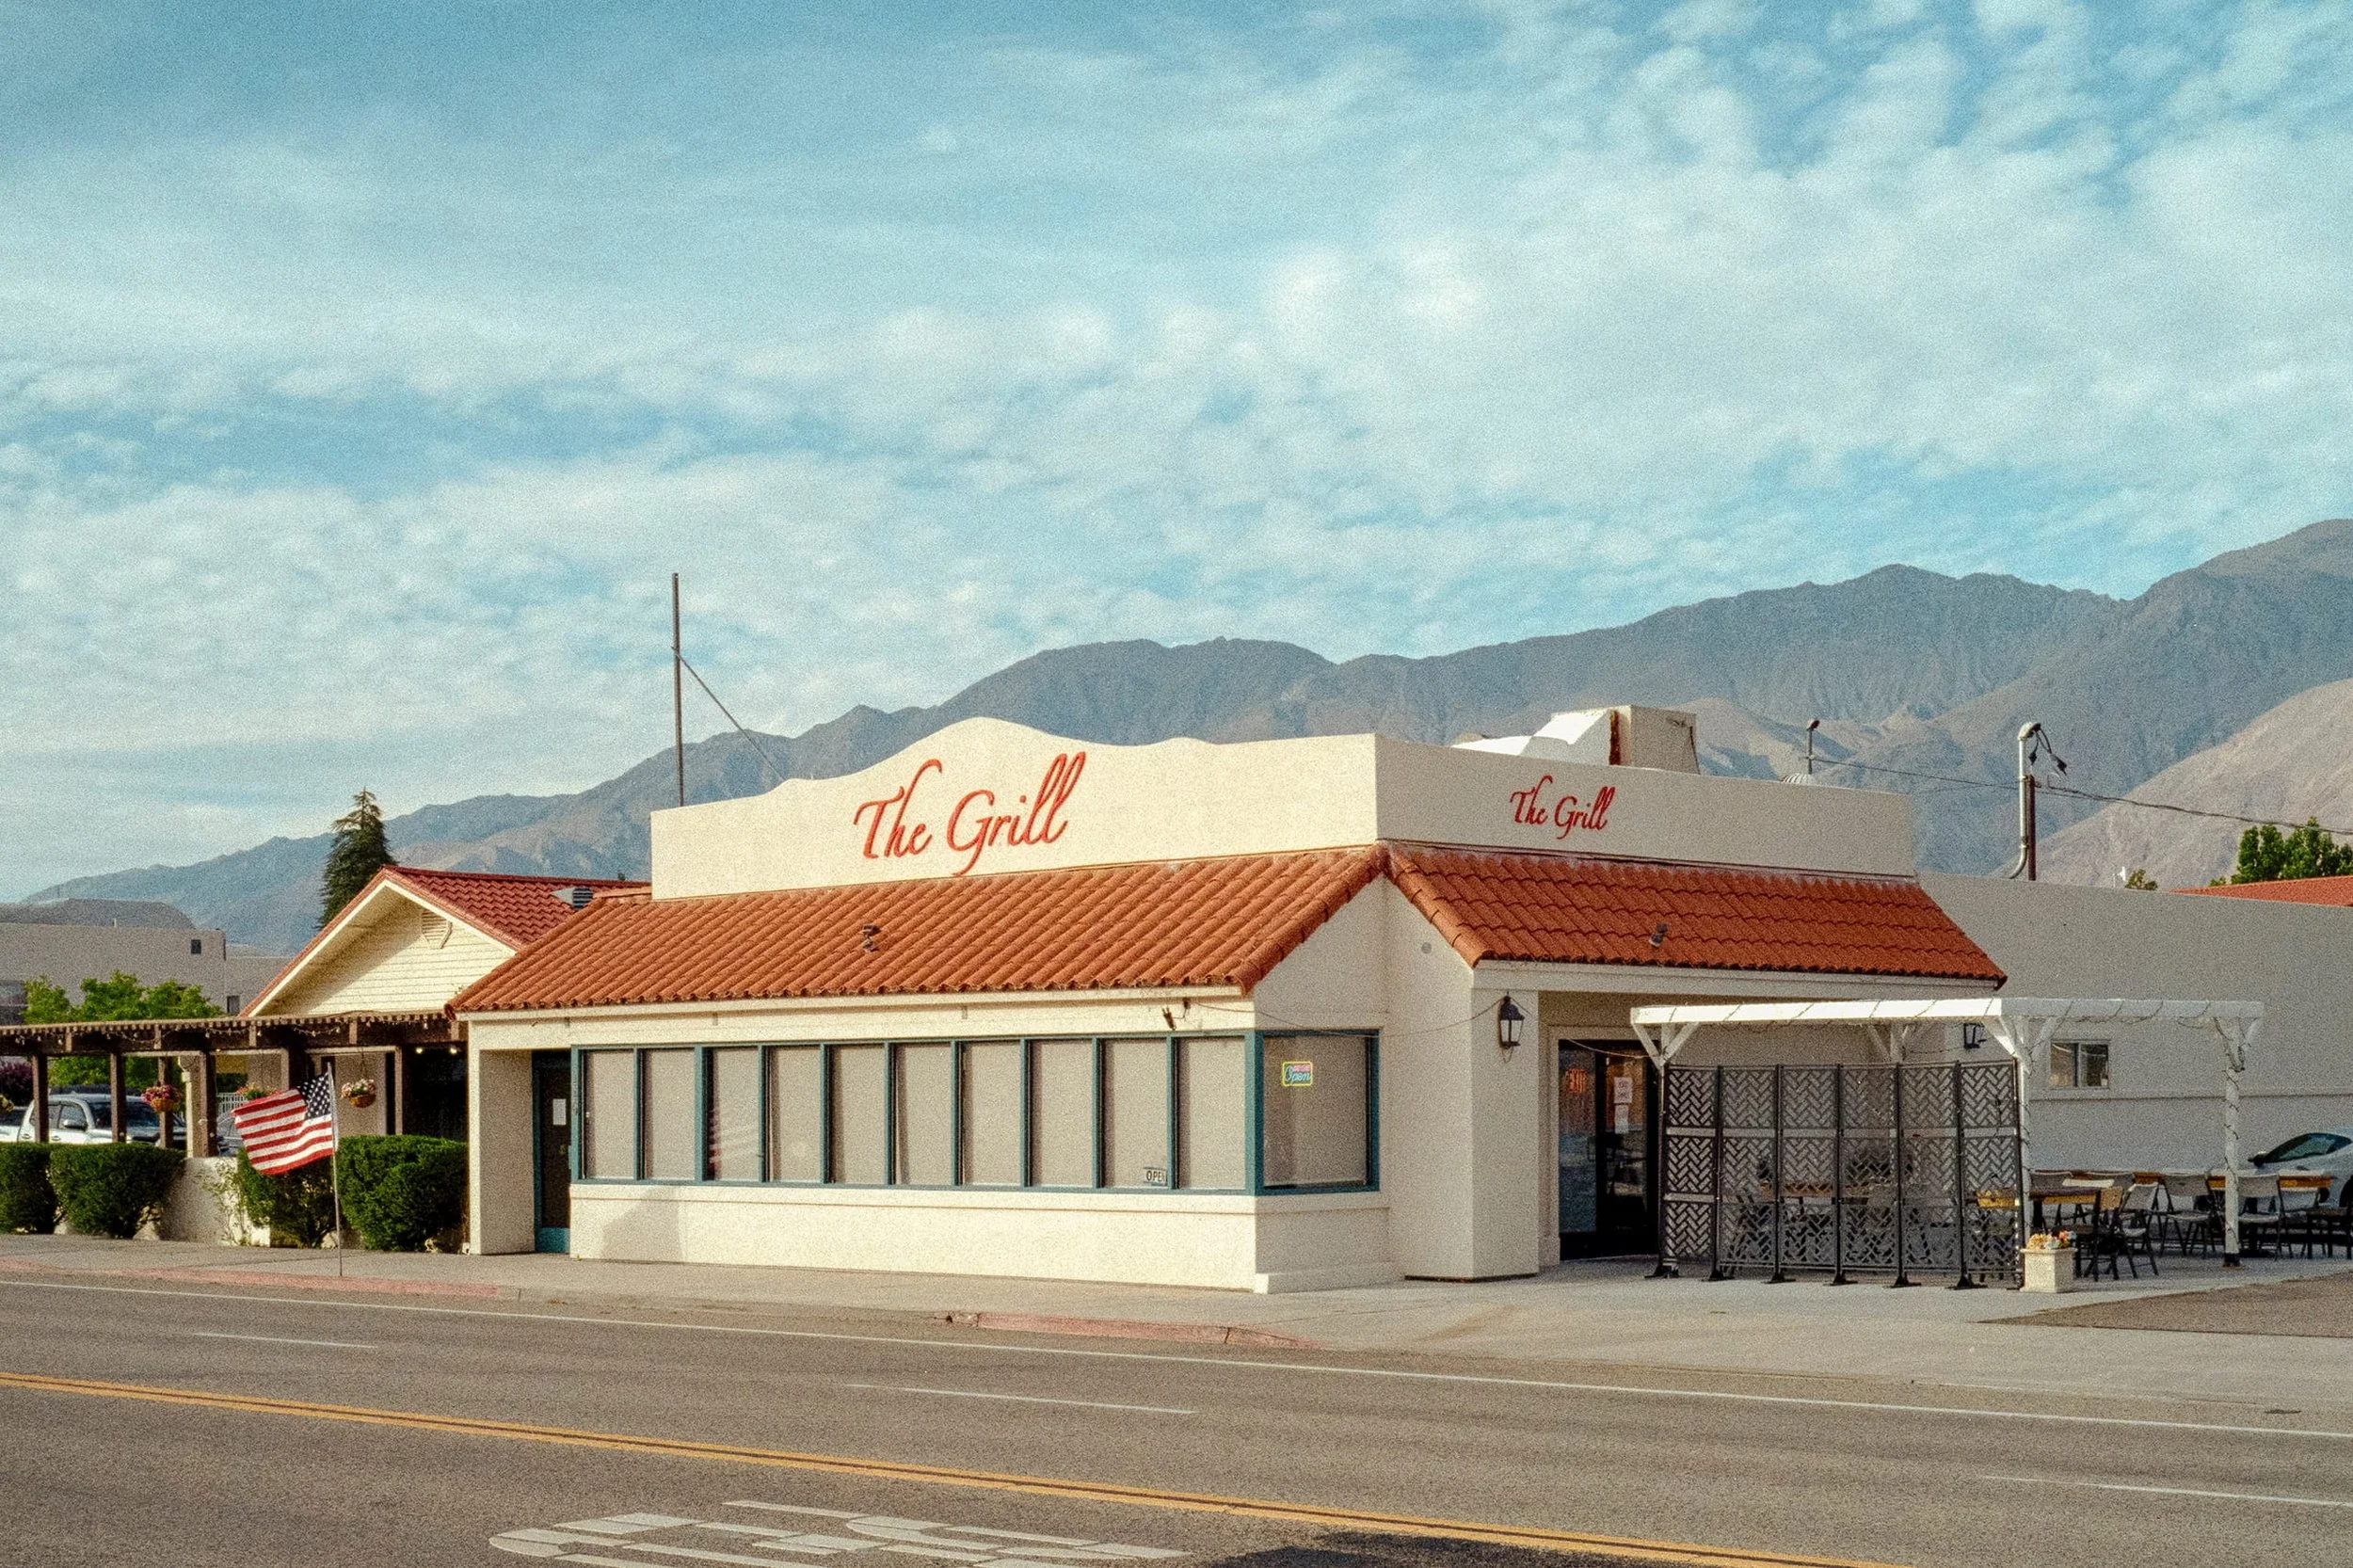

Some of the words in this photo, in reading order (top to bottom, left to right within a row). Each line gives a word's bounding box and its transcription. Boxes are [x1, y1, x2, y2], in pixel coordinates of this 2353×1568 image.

[853, 759, 942, 858] The
[946, 751, 1086, 876] Grill
[1510, 775, 1553, 824] The
[1554, 786, 1615, 840] Grill
[1145, 1170, 1165, 1181] OPEN
